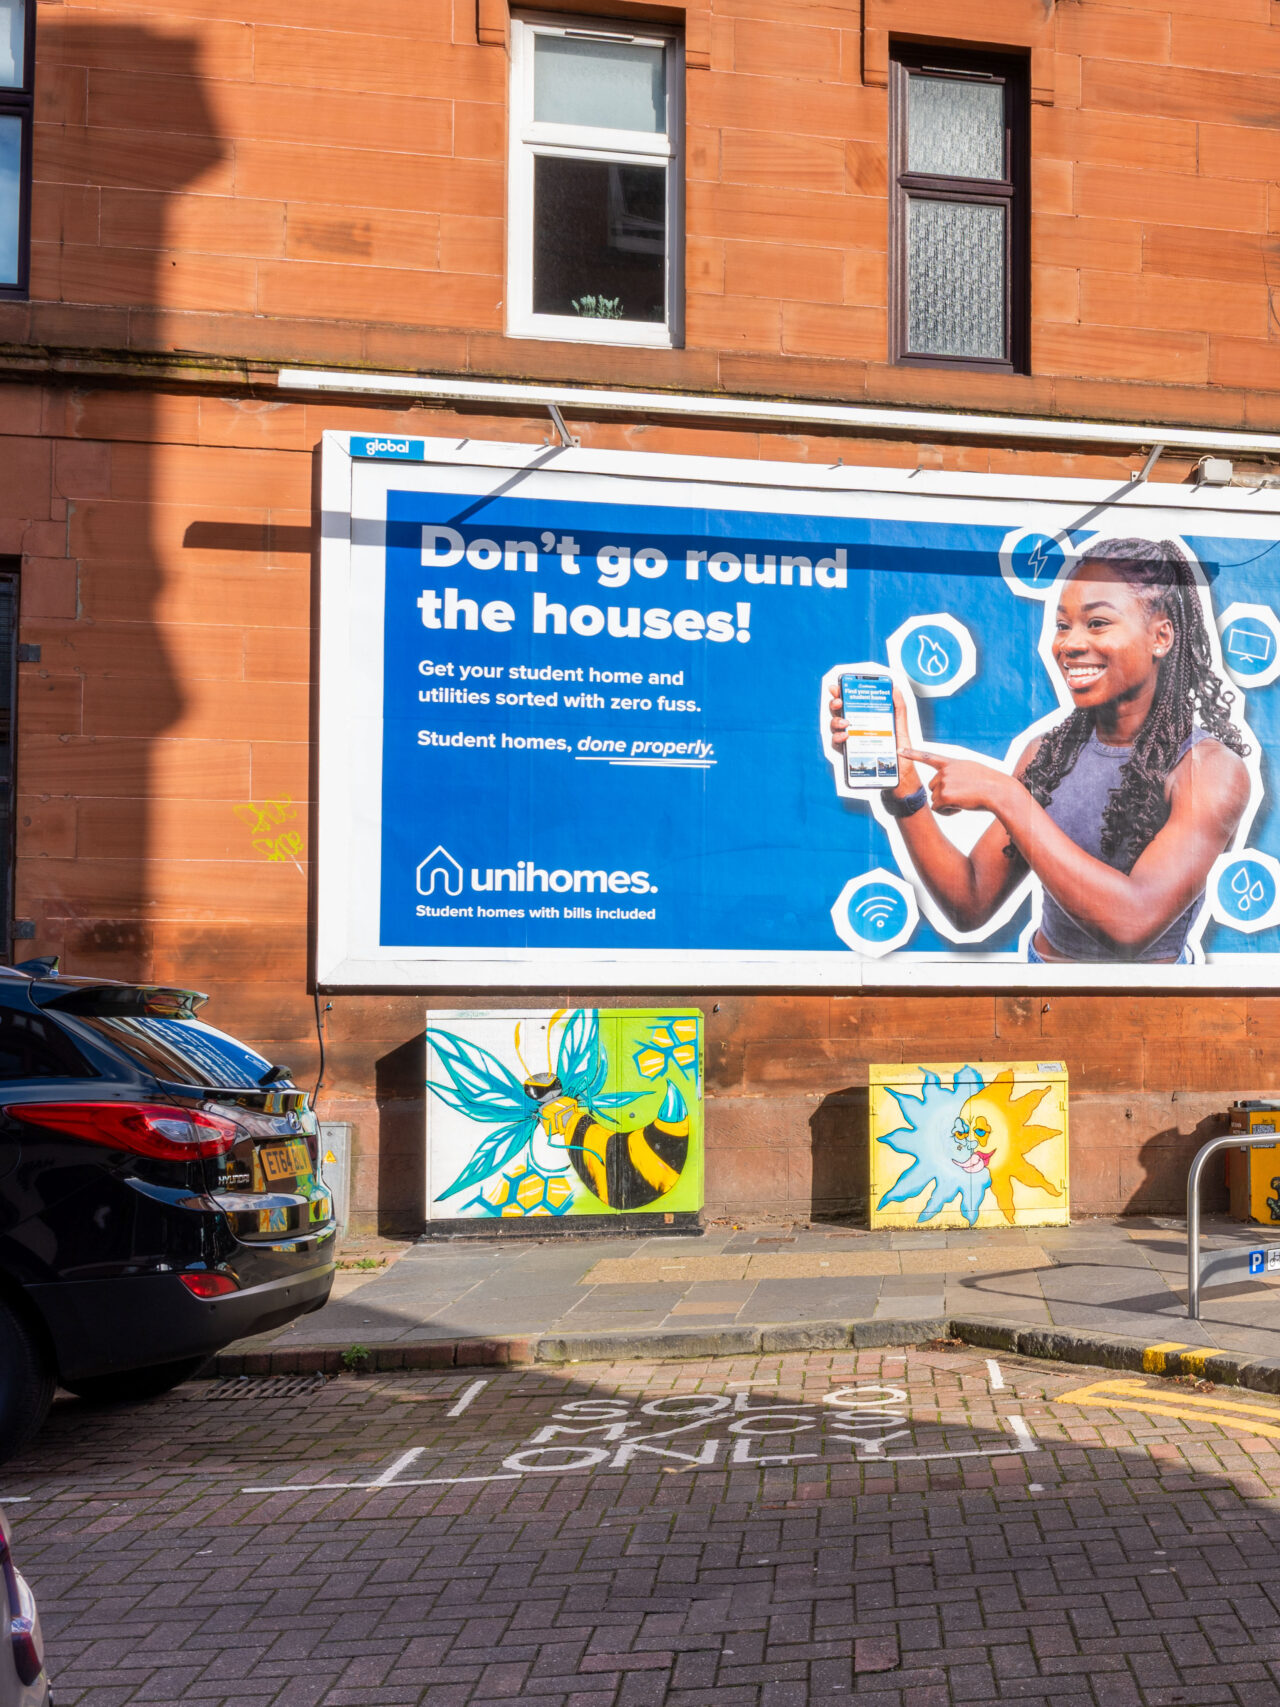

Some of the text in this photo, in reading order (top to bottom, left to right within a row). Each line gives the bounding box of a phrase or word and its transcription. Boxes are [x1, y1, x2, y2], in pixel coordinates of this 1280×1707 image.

[366, 438, 409, 455] global
[597, 543, 668, 588] go
[686, 549, 848, 589] round
[417, 587, 752, 644] the houses!
[418, 660, 684, 686] Get your student home and
[418, 687, 702, 713] utilities sorted with zero fuss.
[417, 730, 715, 758] Student homes, done properly.
[471, 861, 659, 894] unihomes.
[415, 905, 656, 920] Student homes with bills included
[218, 1174, 250, 1185] HYUNDAI
[1252, 1253, 1263, 1271] P
[552, 1385, 908, 1420] SOLO
[502, 1430, 910, 1472] ONLY
